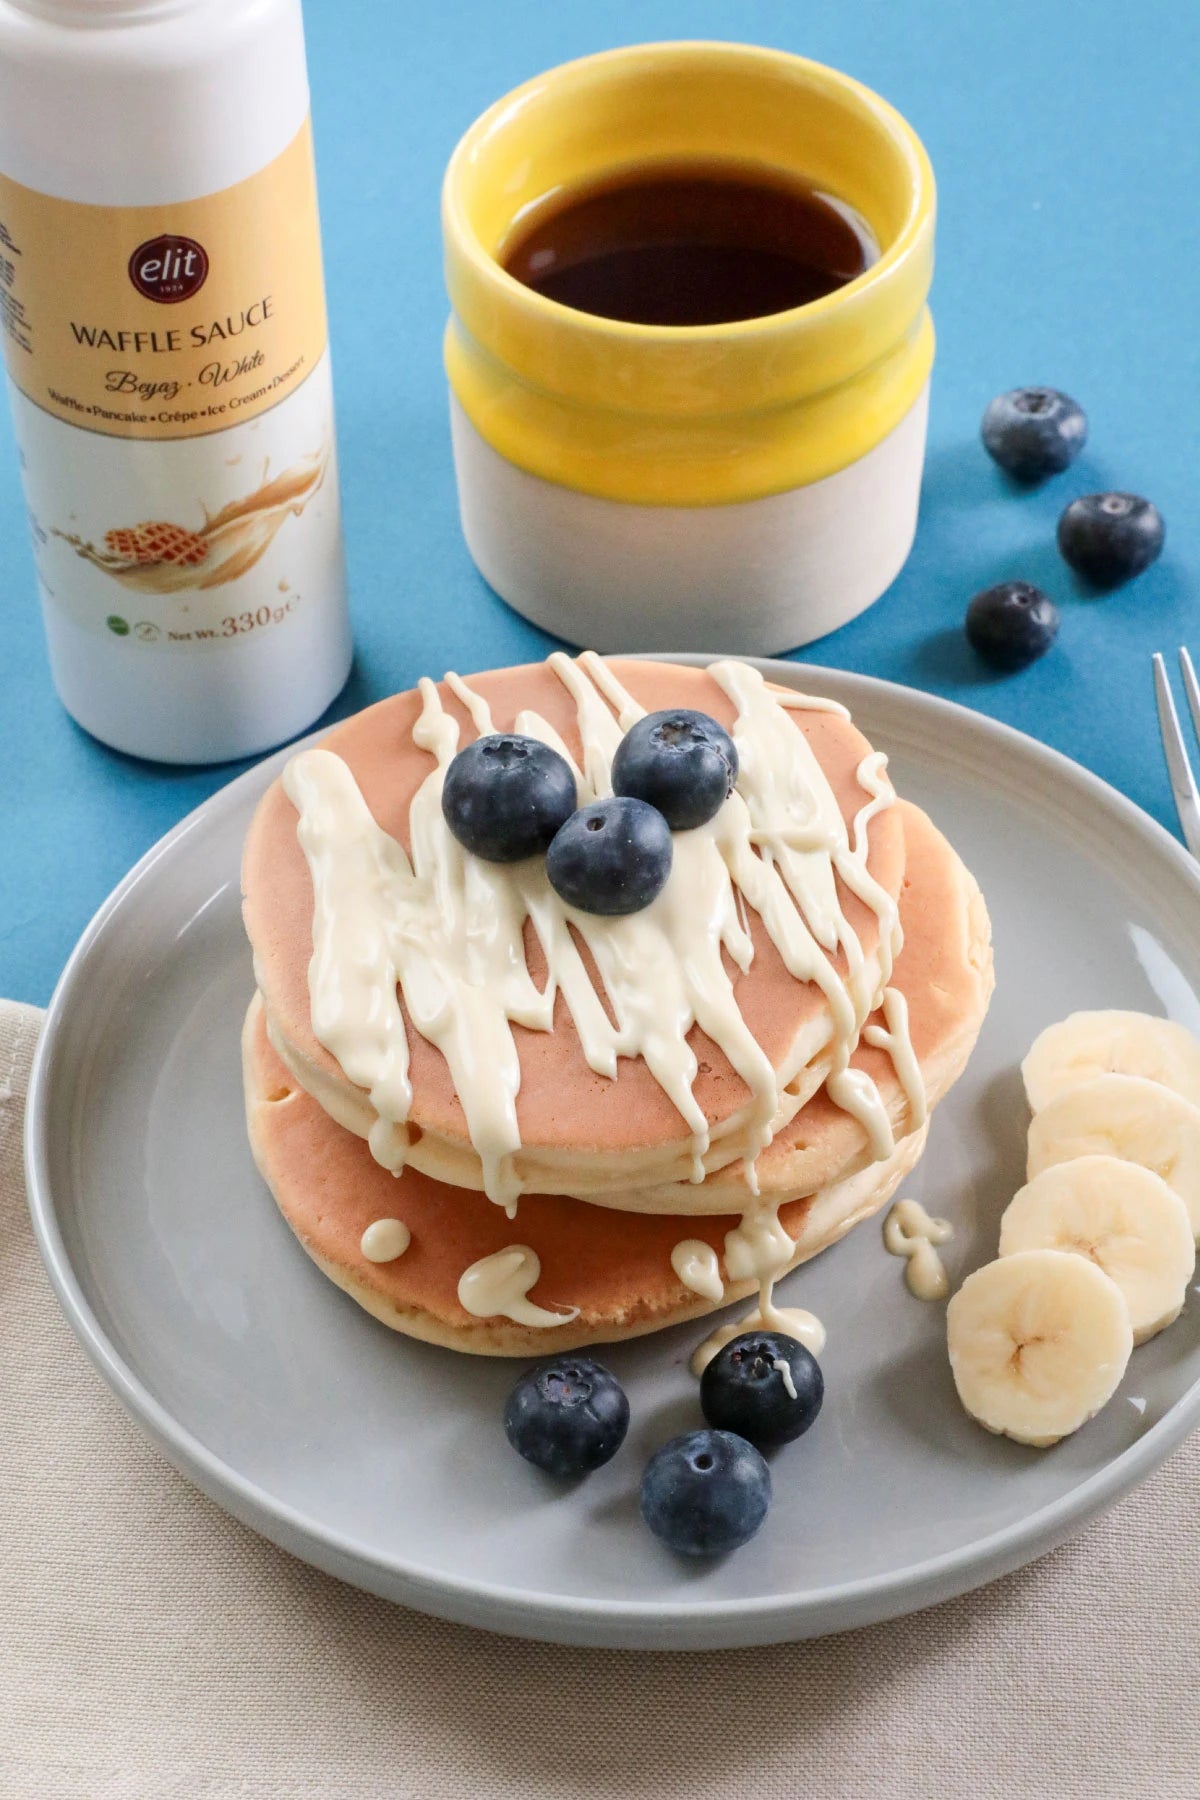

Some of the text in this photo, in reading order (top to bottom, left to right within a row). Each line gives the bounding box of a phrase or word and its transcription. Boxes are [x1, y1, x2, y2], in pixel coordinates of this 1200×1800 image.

[140, 248, 197, 283] elit
[70, 295, 274, 353] WAFFLE SAUCE
[104, 349, 265, 401] Beyaz White
